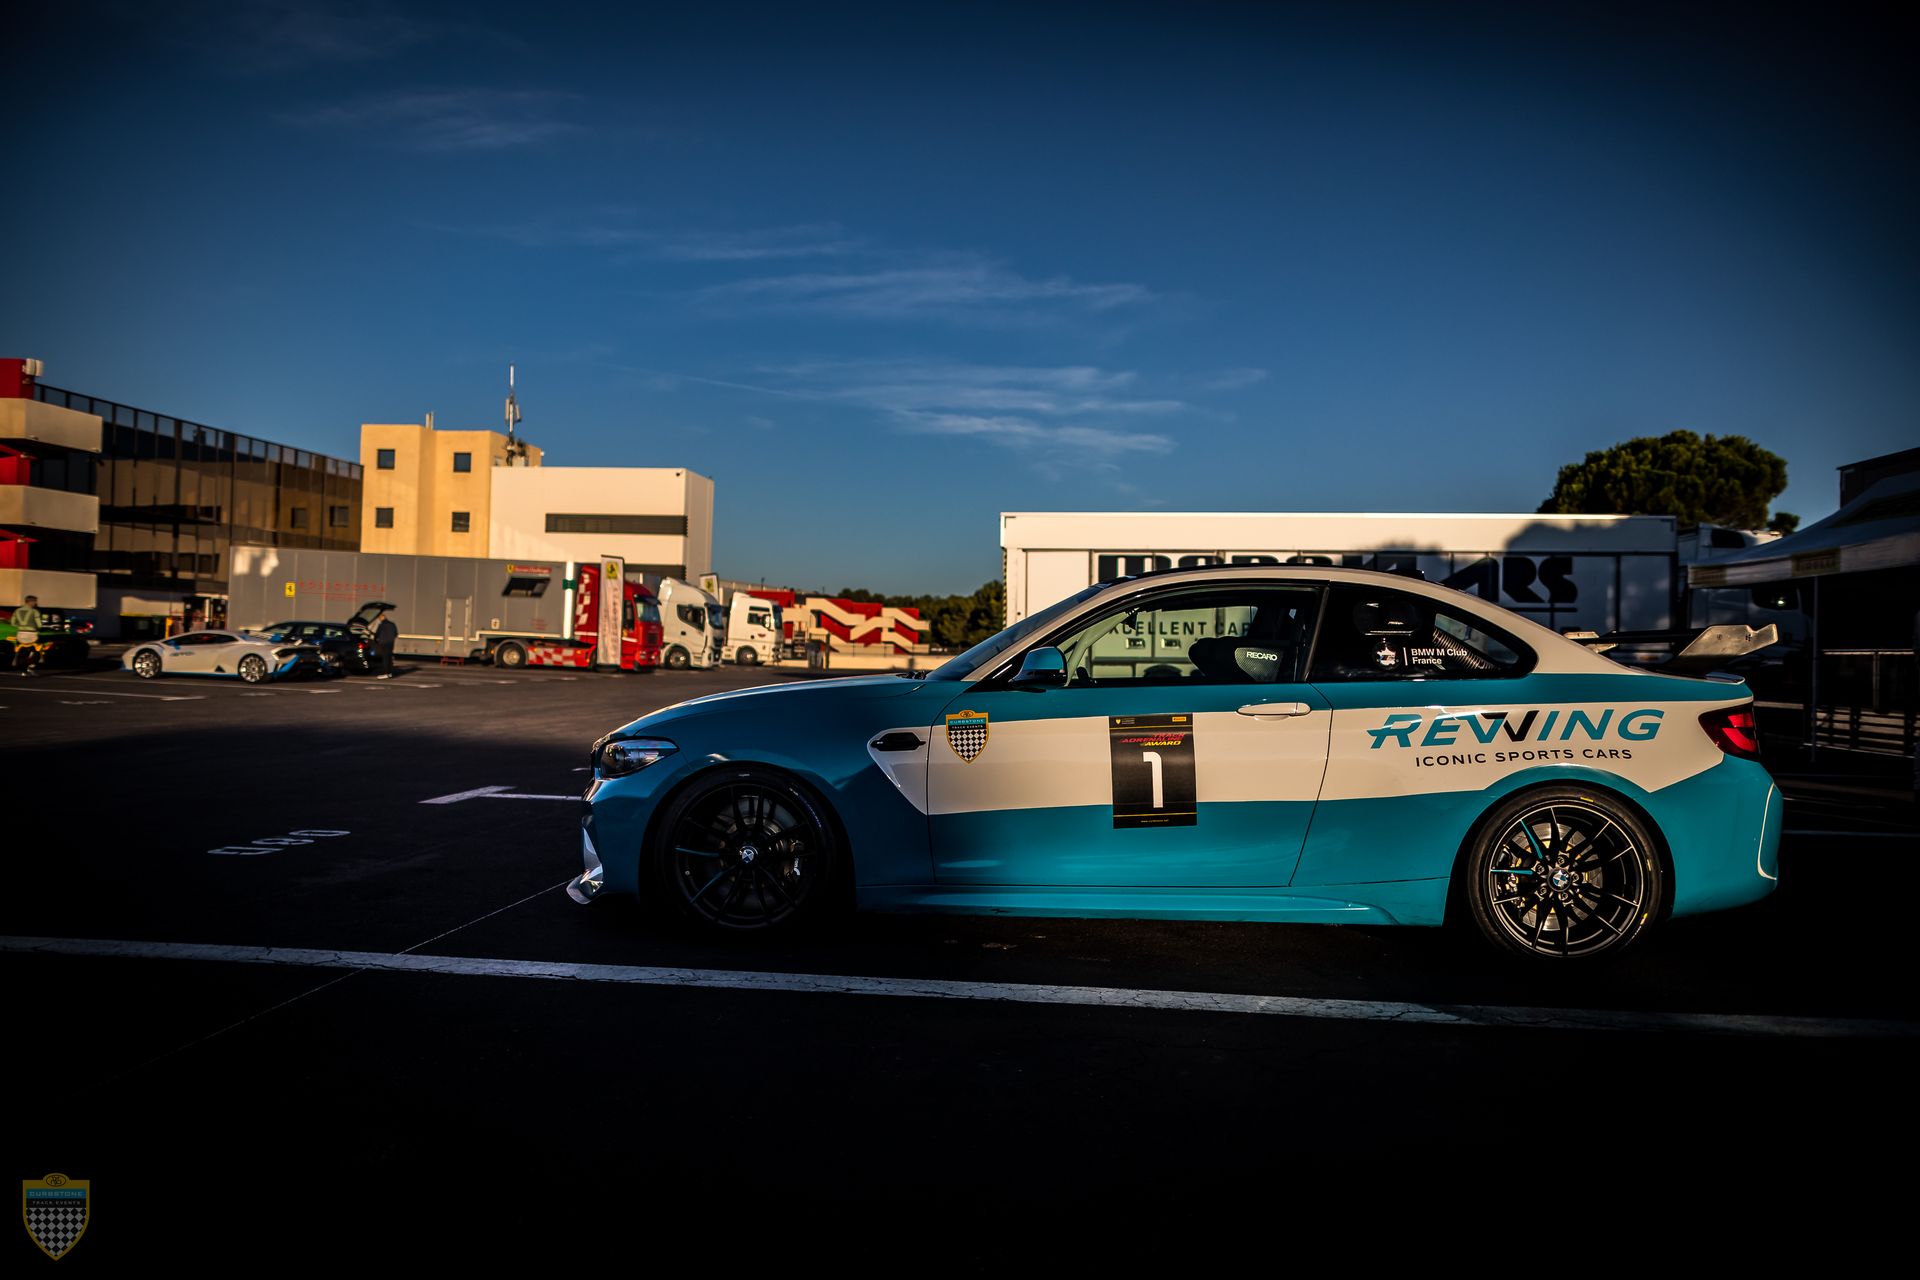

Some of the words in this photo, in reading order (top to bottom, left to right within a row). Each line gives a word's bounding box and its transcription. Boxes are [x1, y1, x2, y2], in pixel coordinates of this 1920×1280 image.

[1109, 621, 1207, 635] XCELLENT
[1246, 651, 1278, 661] RECARO
[1411, 648, 1436, 656] BMW
[1436, 648, 1446, 656] M
[1446, 648, 1468, 656] Club
[1411, 656, 1443, 665] France
[1415, 753, 1487, 767] ICONIC
[1495, 749, 1574, 763] SPORTS
[1582, 749, 1633, 760] CARS
[1143, 751, 1163, 808] 1
